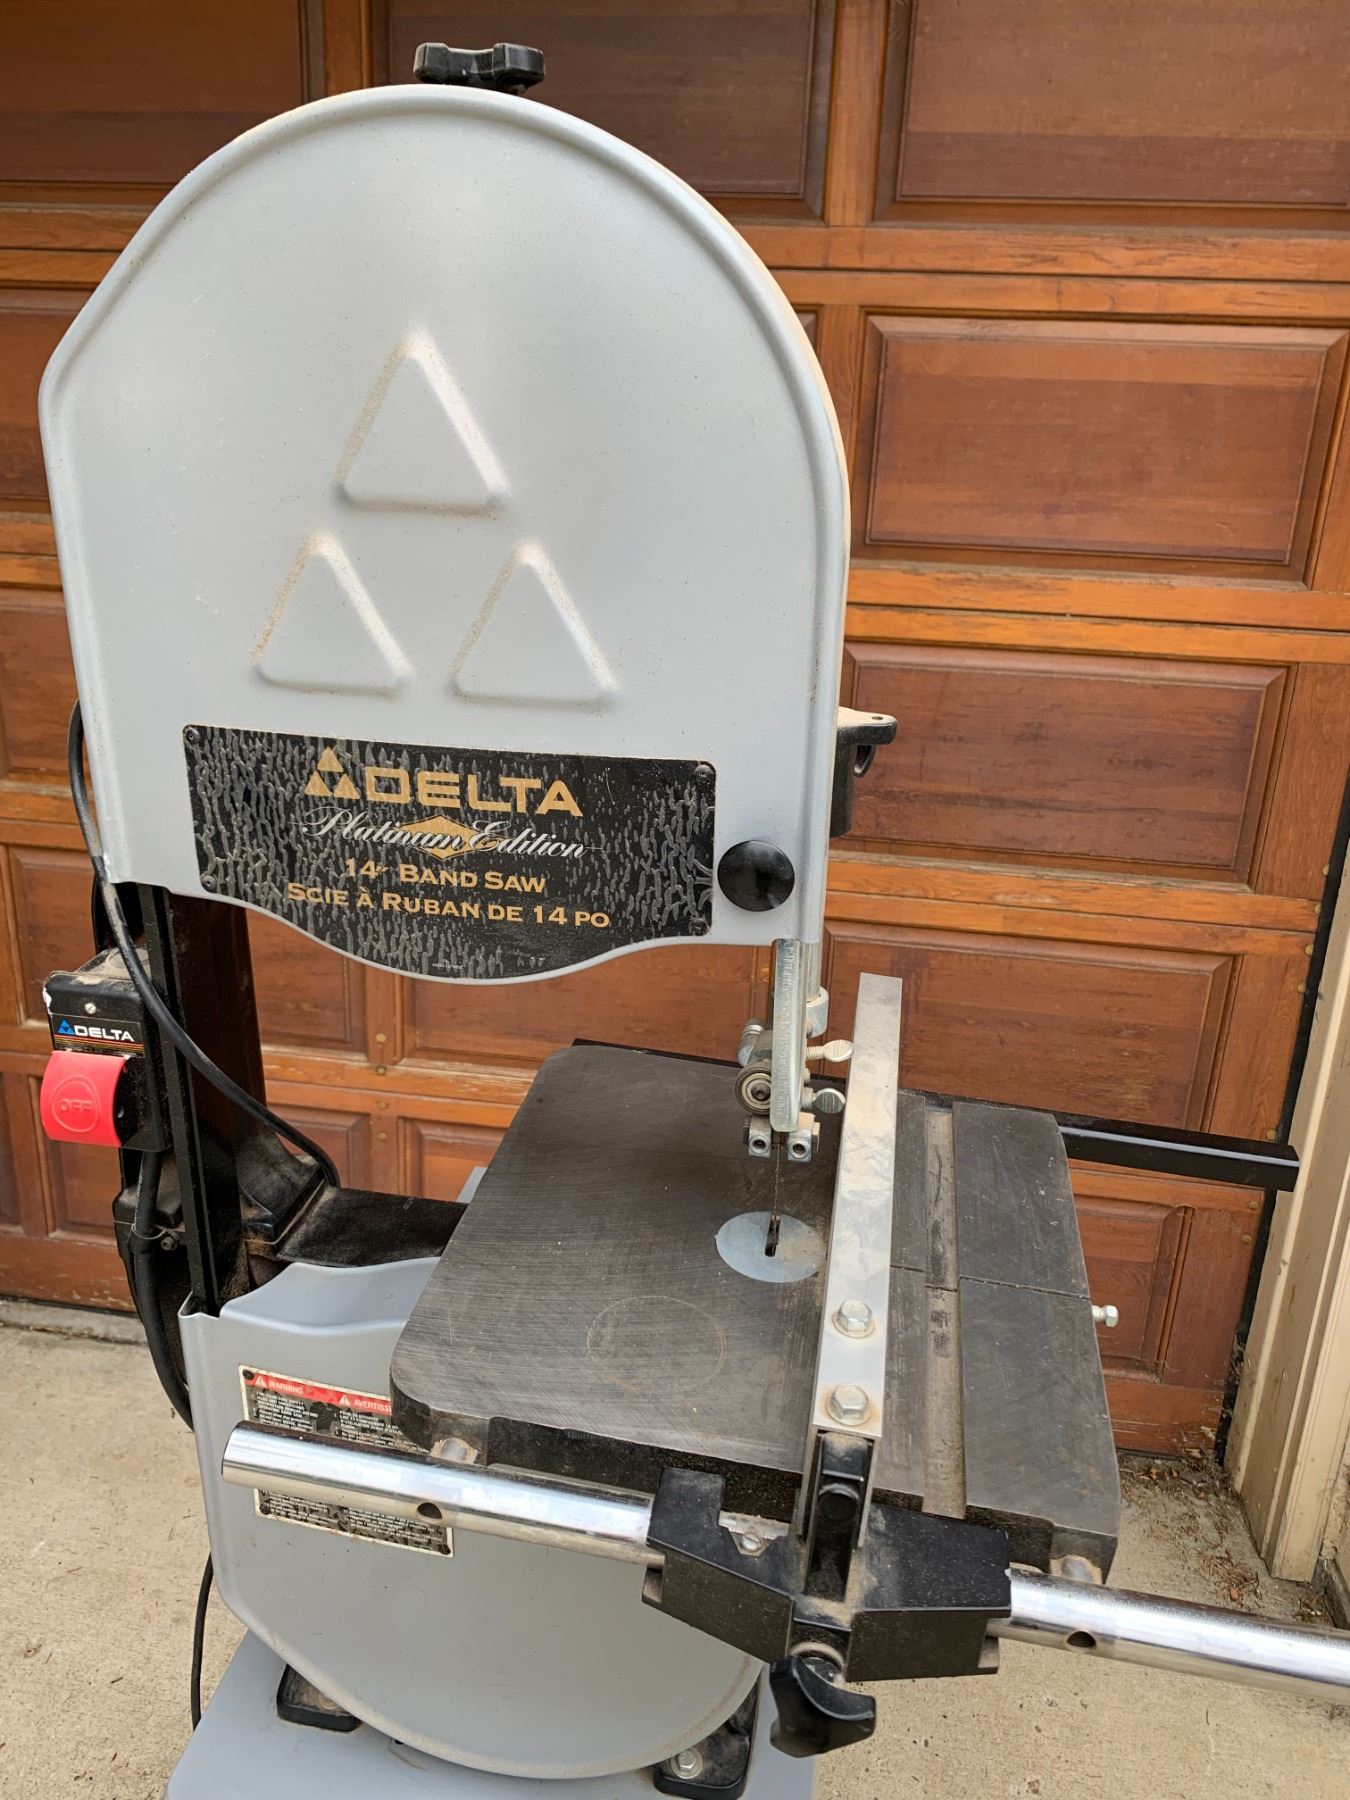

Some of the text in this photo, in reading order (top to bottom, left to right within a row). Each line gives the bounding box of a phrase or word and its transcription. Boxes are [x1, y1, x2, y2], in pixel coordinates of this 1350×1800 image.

[365, 766, 583, 817] DELTA
[302, 806, 588, 858] Platinum Edition
[399, 863, 477, 890] BAND
[484, 871, 546, 893] SAW
[288, 882, 610, 928] SCIE À RUBAN DE 14 PO
[74, 1025, 135, 1042] DELTA
[60, 1098, 93, 1113] OFF
[268, 1380, 304, 1394] WARNING
